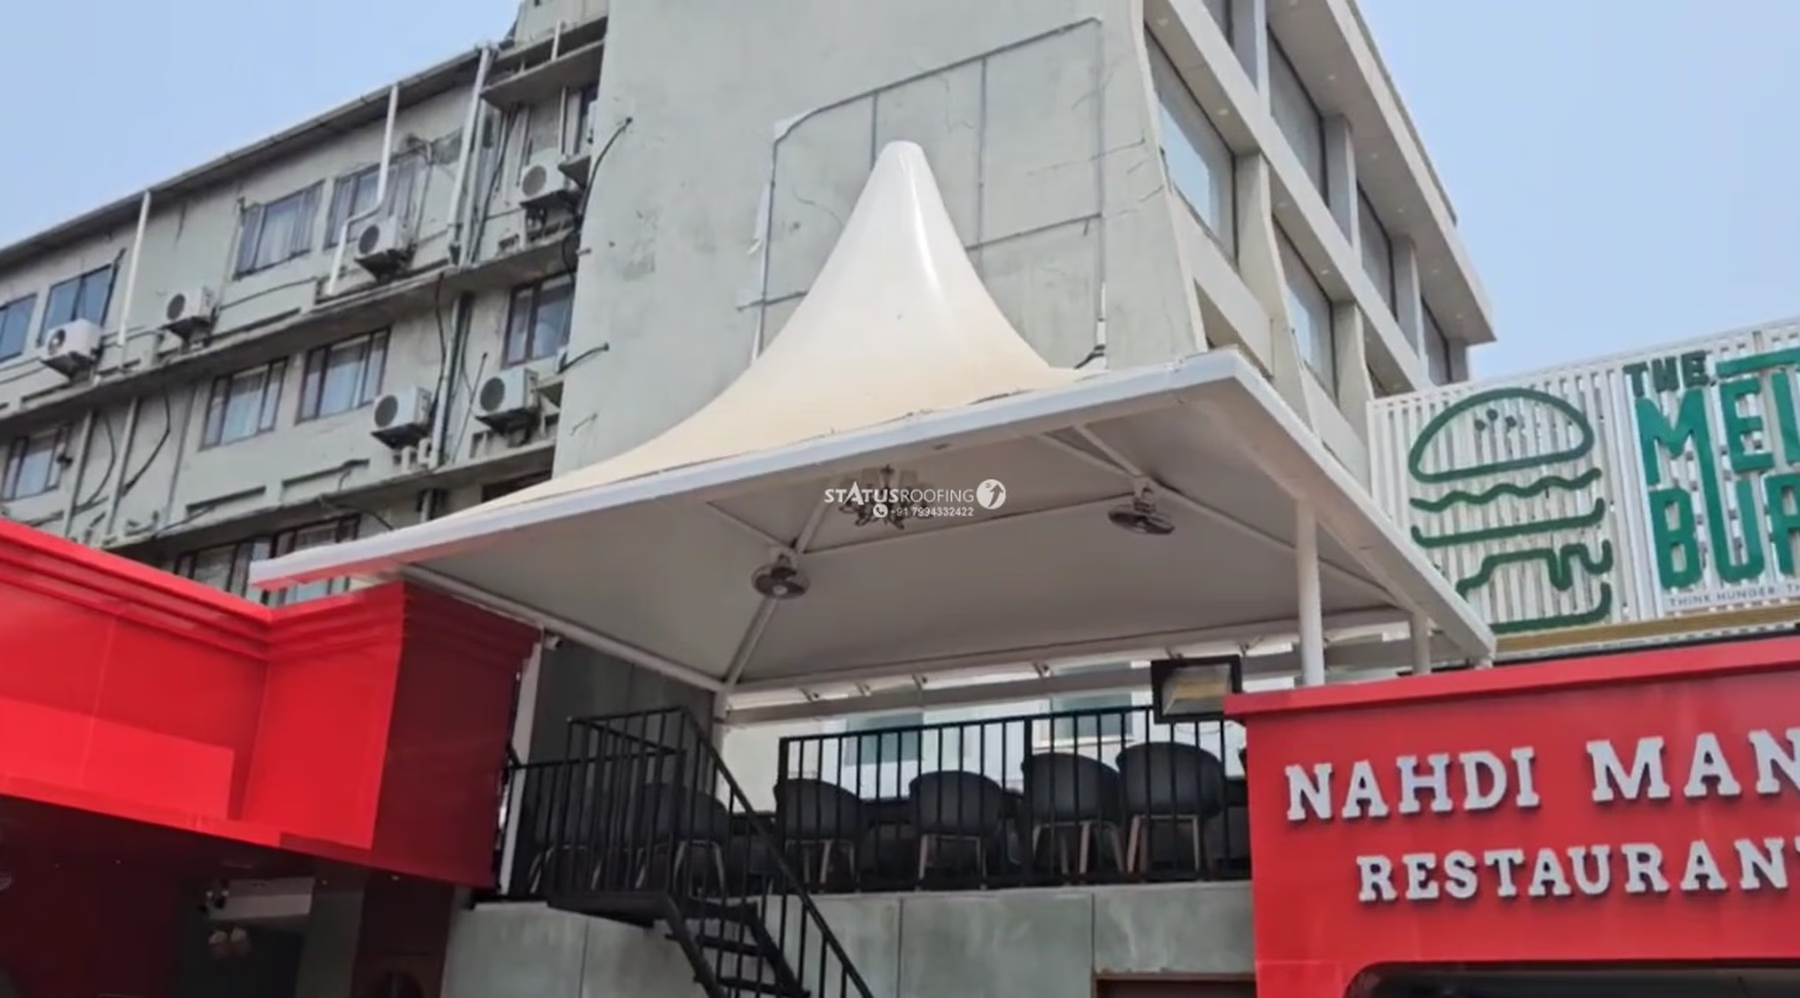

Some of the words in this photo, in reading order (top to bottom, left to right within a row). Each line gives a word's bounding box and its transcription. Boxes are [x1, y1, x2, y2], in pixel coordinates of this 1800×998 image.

[1622, 350, 1709, 398] THE
[1634, 347, 1800, 488] MEL
[1285, 746, 1540, 821] NAHDI
[1586, 727, 1800, 802] MAN
[1356, 836, 1800, 902] RESTAURAN
